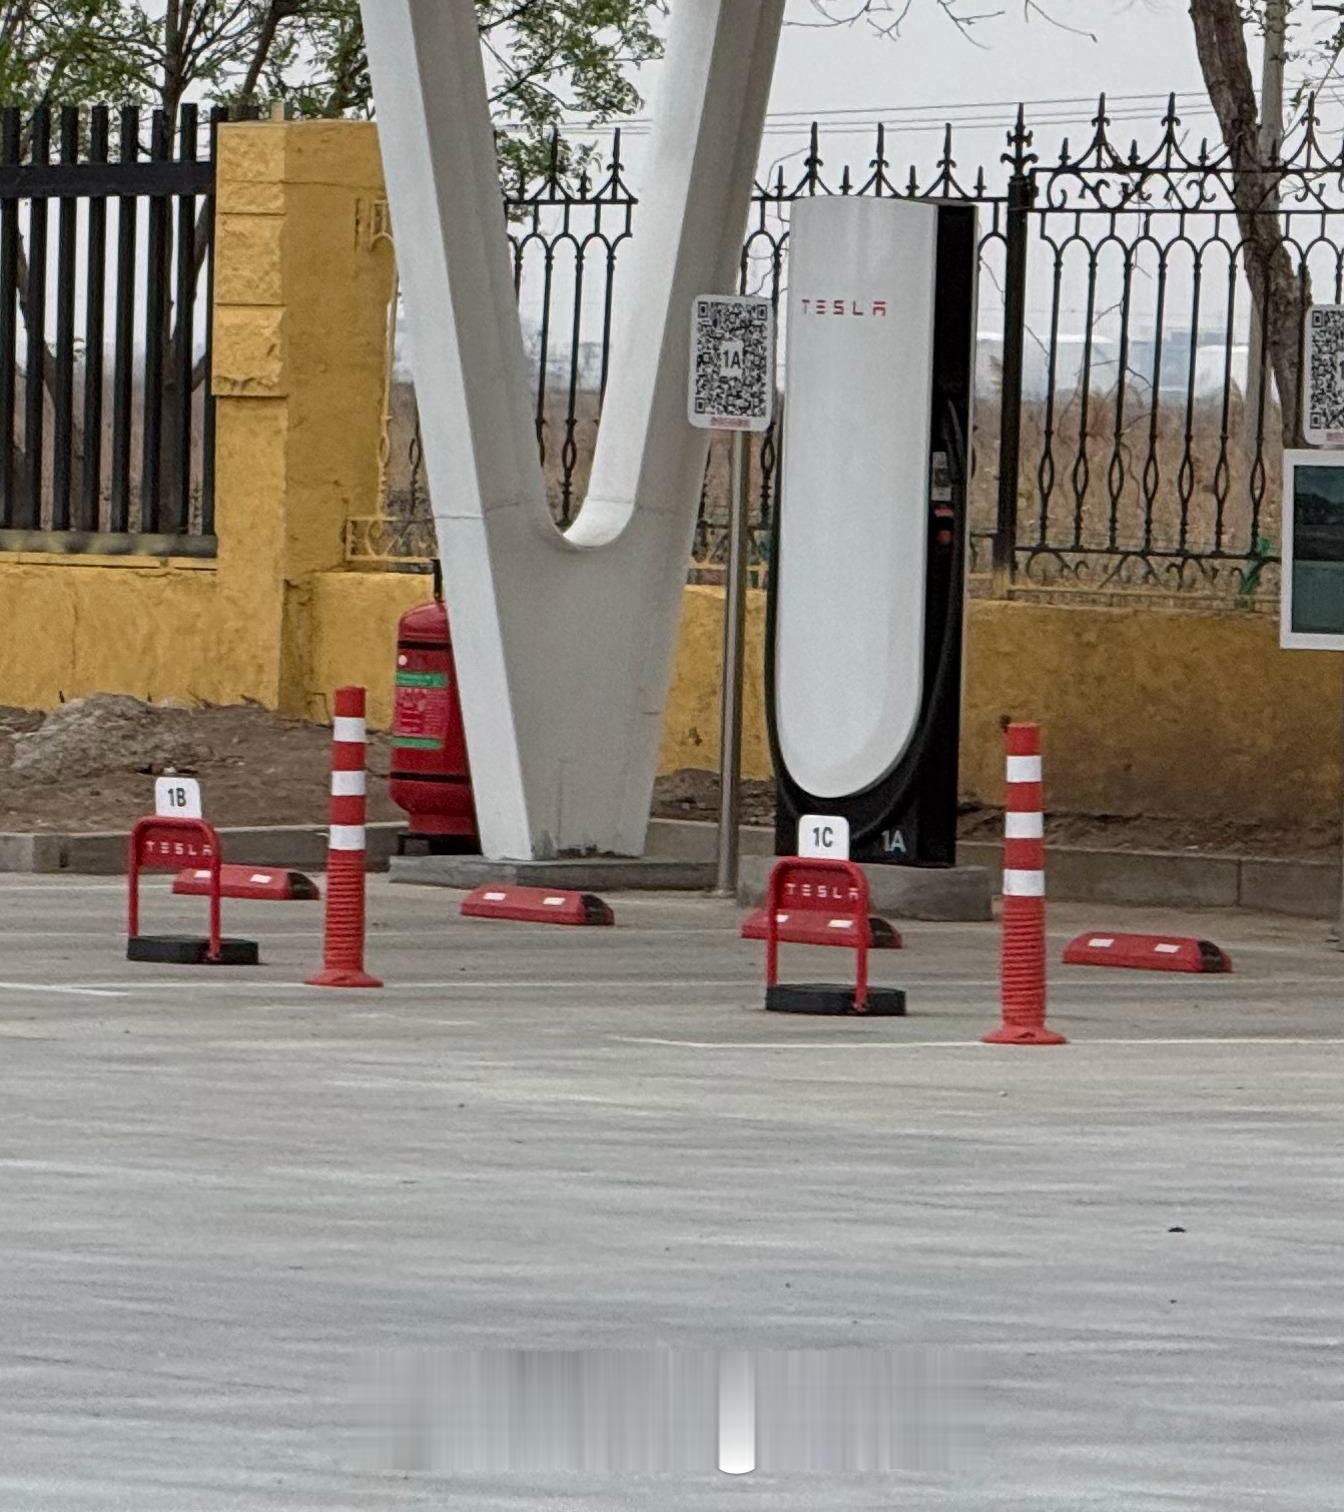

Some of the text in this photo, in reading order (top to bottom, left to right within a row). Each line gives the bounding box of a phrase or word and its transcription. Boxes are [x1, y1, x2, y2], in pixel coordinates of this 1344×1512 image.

[801, 299, 886, 316] TESLA
[722, 348, 741, 369] 1A
[168, 788, 186, 807] 1B
[812, 826, 833, 848] 1C
[881, 830, 906, 853] 1A
[146, 841, 212, 856] TESLA
[786, 883, 859, 899] TESLA
